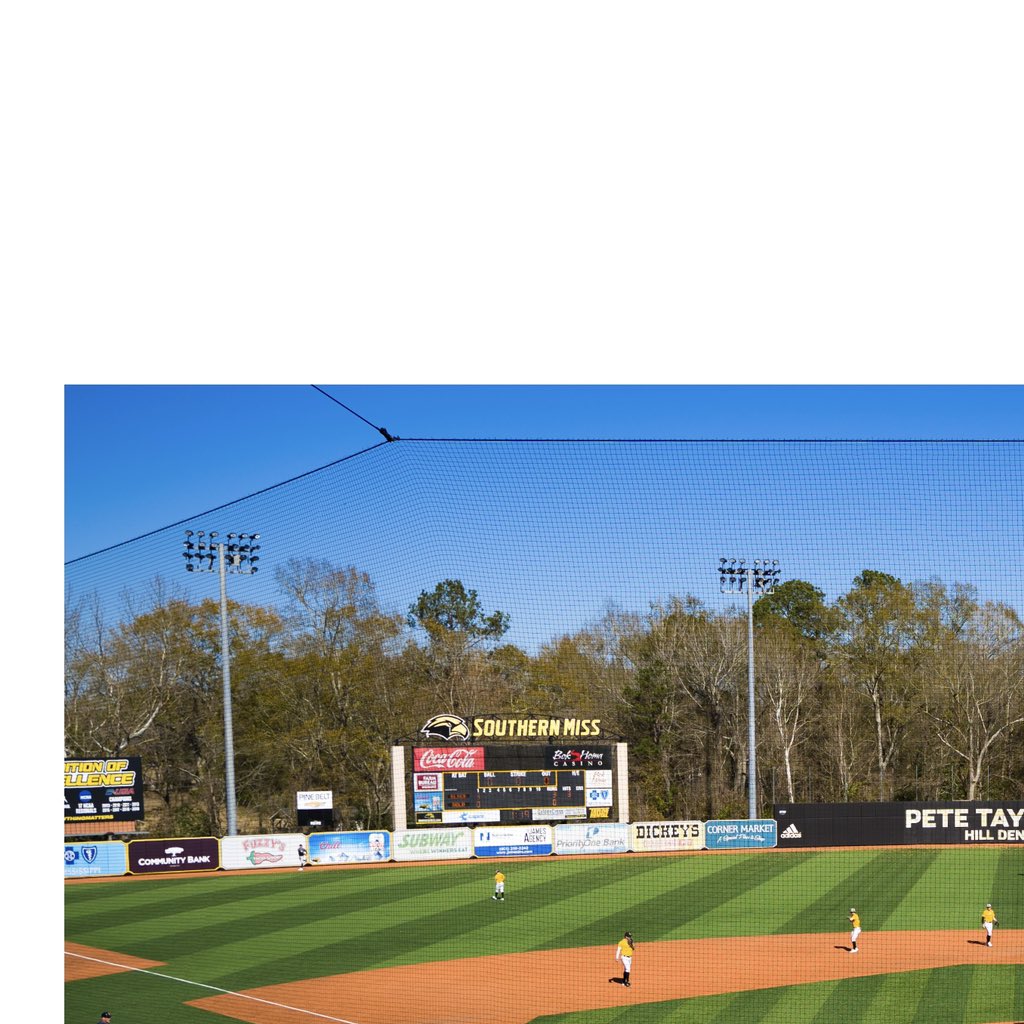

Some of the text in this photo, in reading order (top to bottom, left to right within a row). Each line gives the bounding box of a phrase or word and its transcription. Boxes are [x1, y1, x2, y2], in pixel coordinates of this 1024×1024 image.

[472, 718, 601, 737] SOUTHERN MISS
[420, 749, 478, 769] Coca-Cola
[106, 760, 128, 772] OF
[64, 772, 135, 787] LLENCE
[905, 808, 969, 829] PETE
[636, 824, 699, 839] DICKEYS
[707, 824, 774, 834] CORNER MARKET
[780, 831, 802, 839] adidas
[964, 829, 996, 841] HILL
[398, 831, 464, 849] SUBWAY
[557, 838, 625, 849] PriorityOne Bank
[138, 857, 186, 866] COMMUNITY
[187, 855, 211, 864] BANK
